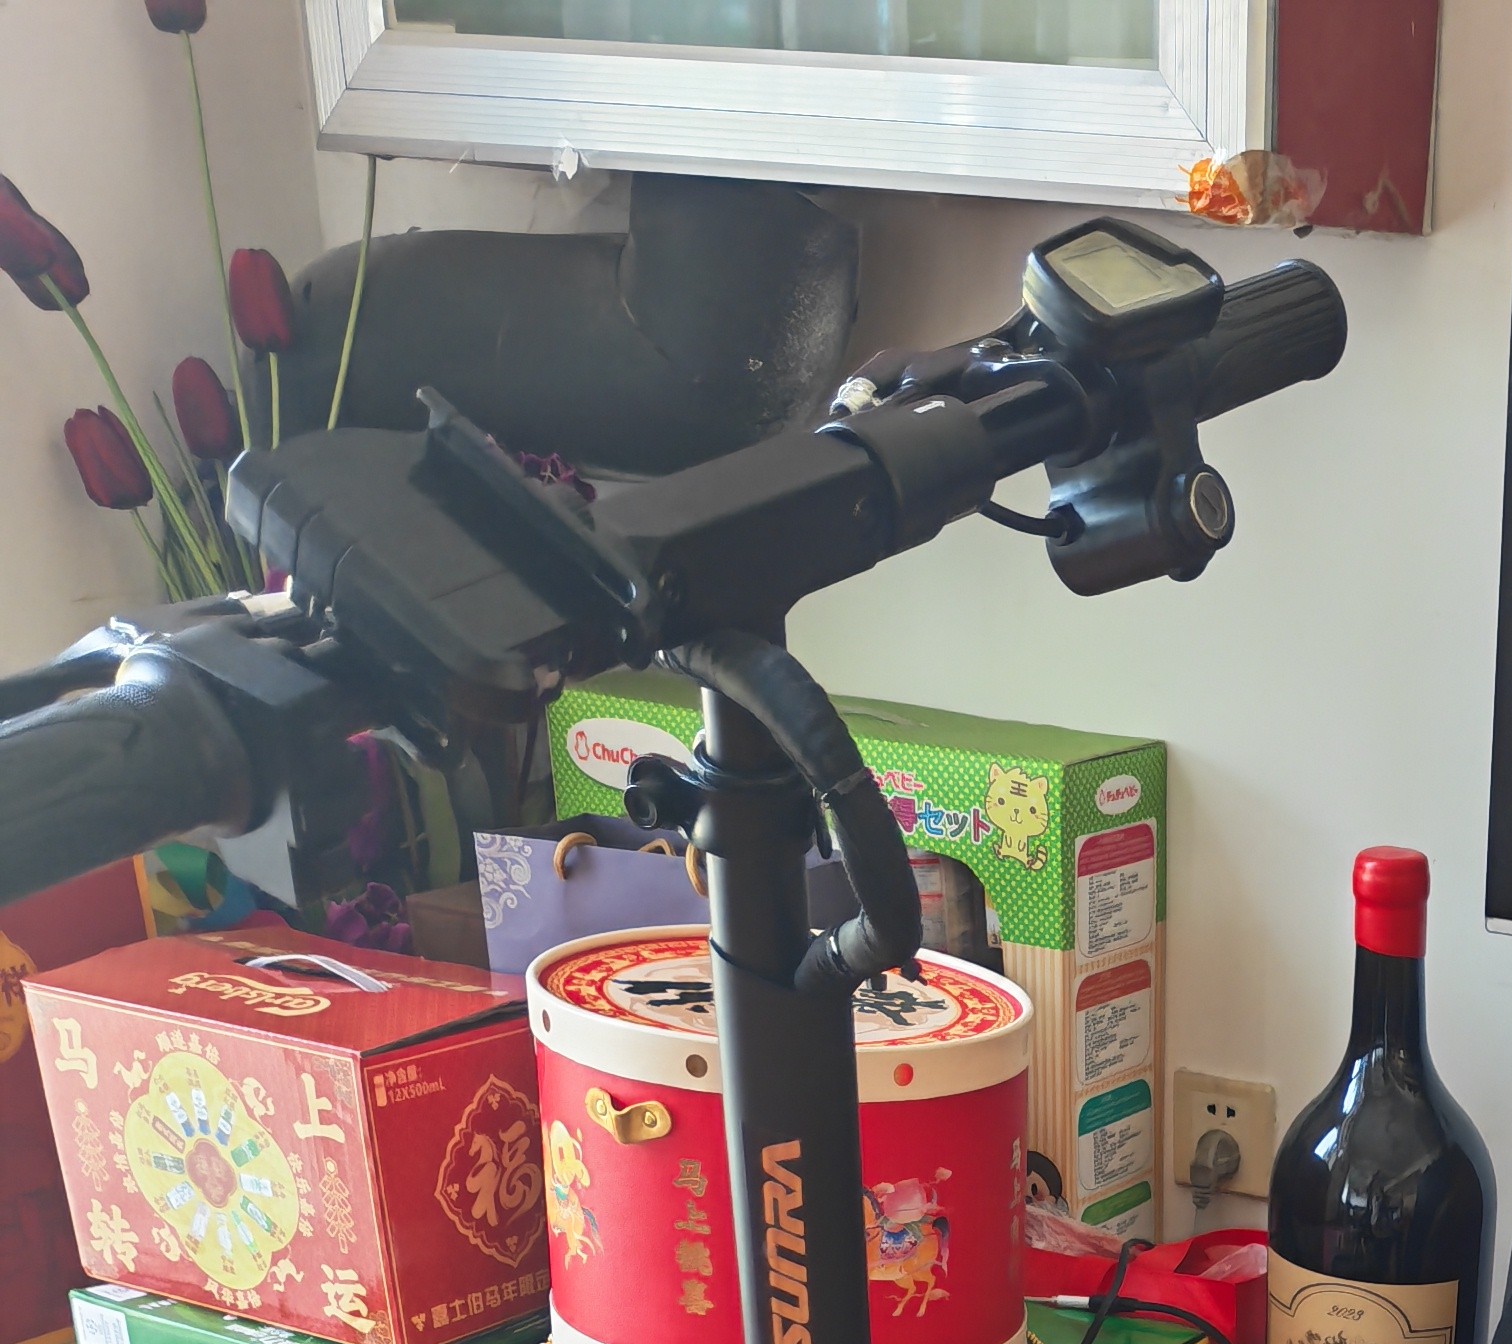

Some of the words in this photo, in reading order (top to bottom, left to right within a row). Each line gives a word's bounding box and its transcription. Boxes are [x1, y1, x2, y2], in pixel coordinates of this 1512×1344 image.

[168, 972, 331, 1017] Carlsberg
[53, 1017, 98, 1090] 马
[293, 1072, 346, 1144] 上
[86, 1198, 140, 1273] 转
[320, 1263, 377, 1334] 运
[430, 1268, 550, 1330] 嘉士伯马年限定
[1327, 1304, 1365, 1322] 2023
